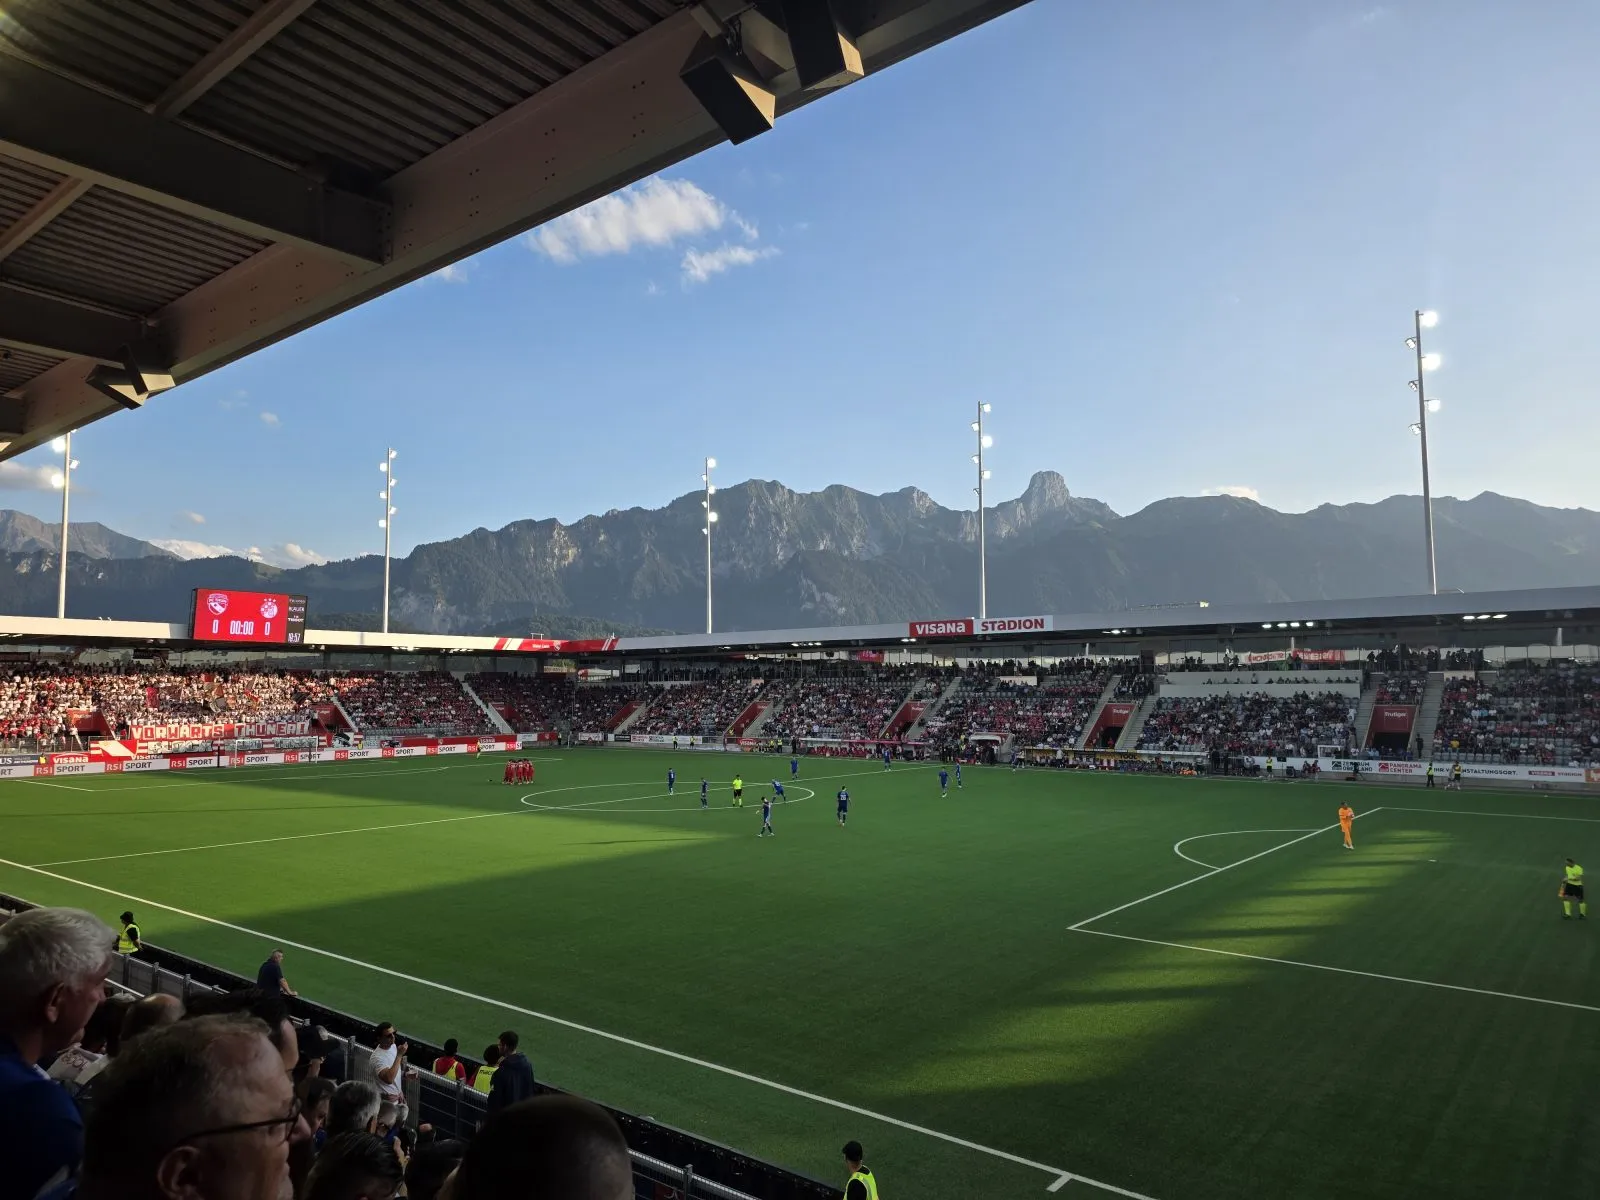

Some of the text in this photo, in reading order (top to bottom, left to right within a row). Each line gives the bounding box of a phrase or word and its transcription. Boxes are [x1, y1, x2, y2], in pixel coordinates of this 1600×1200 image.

[212, 619, 219, 634] 0
[229, 620, 254, 635] 00:00
[264, 621, 271, 636] 0
[106, 763, 122, 771] RSI
[171, 760, 186, 768] RSI
